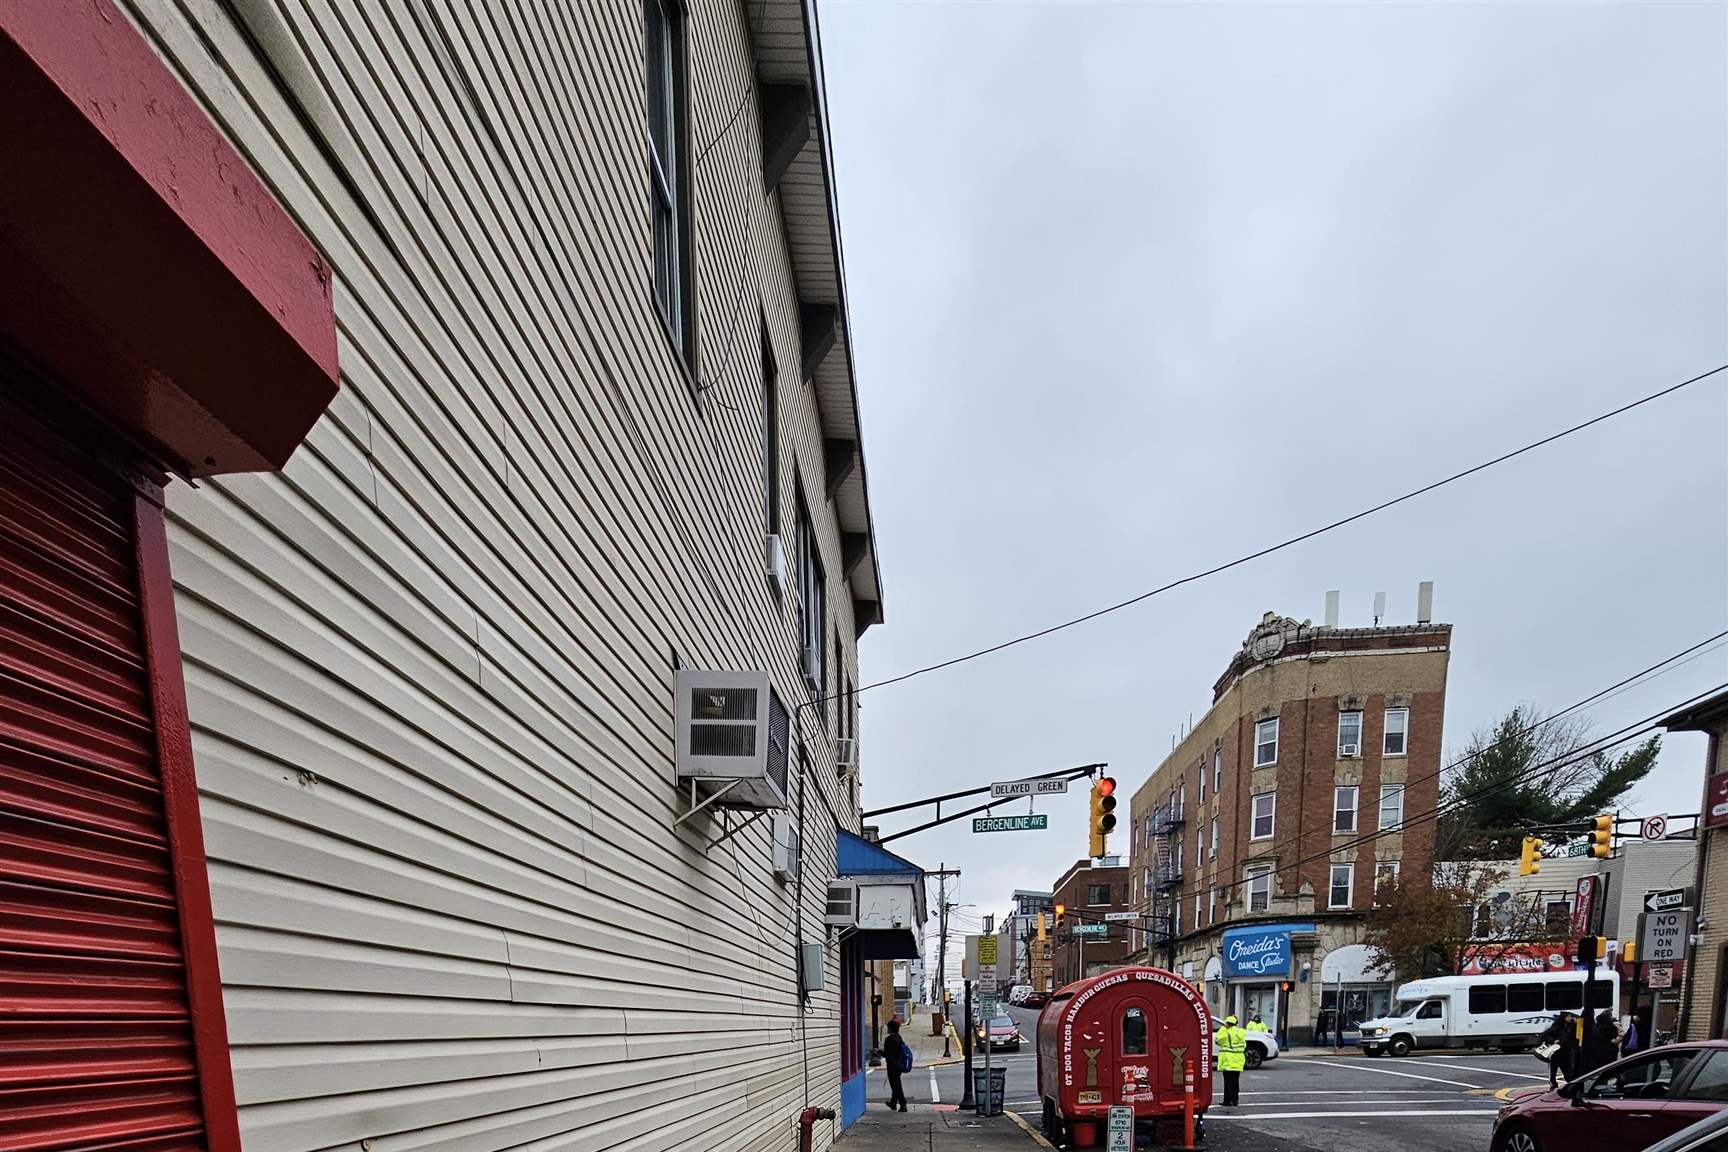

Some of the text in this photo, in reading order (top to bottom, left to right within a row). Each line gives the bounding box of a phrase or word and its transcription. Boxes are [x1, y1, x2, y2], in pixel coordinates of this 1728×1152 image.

[995, 781, 1063, 795] DELAYED GREEN
[975, 816, 1045, 832] BERGENLINE AVE
[1656, 895, 1680, 906] ONE WAY
[1657, 915, 1677, 926] NO
[1653, 928, 1678, 937] TURN
[1229, 936, 1284, 961] Oneida's
[1657, 938, 1672, 947] ON
[1654, 949, 1673, 958] RED
[1238, 952, 1285, 974] DANCE Studio
[1135, 972, 1195, 1001] QUESADILLAS
[1193, 1001, 1208, 1036] ELOTES
[1064, 1024, 1073, 1053] TACOS
[1064, 1054, 1072, 1072] DOG
[1200, 1038, 1209, 1079] PINCHOS
[1117, 1132, 1123, 1140] 2
